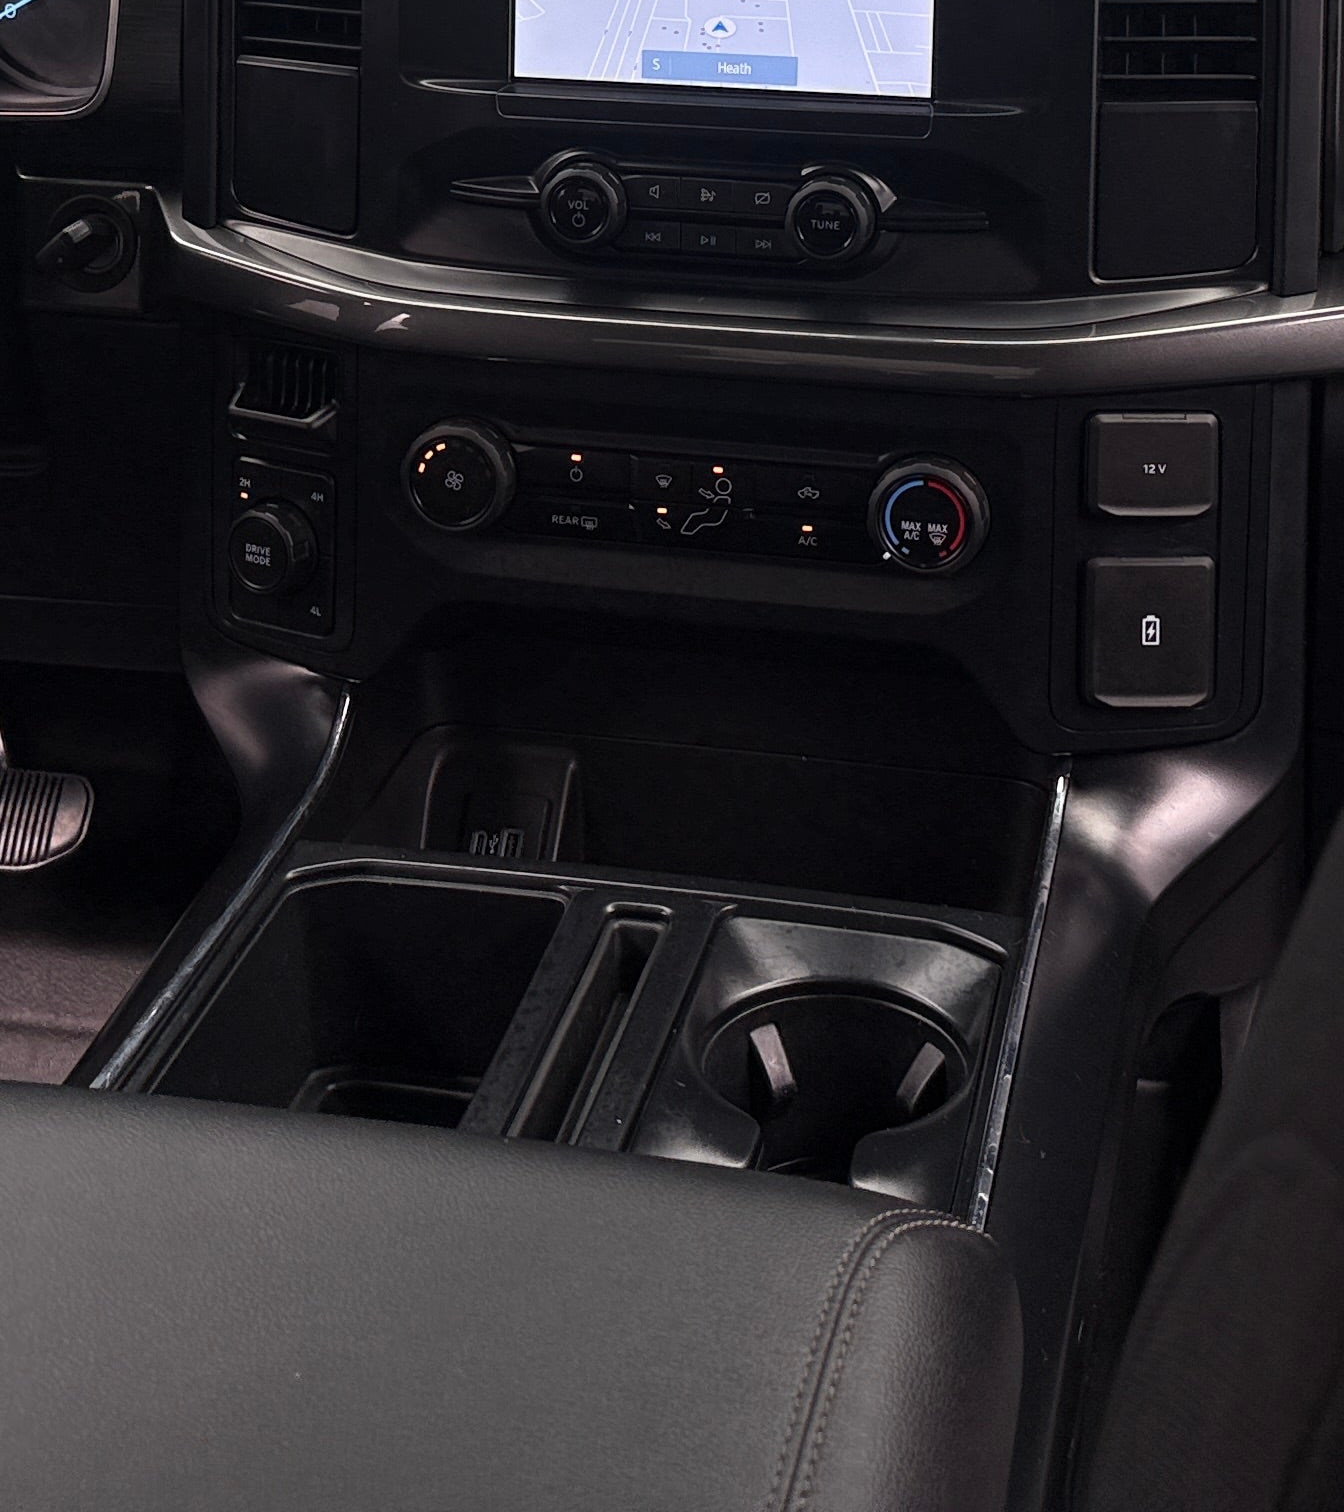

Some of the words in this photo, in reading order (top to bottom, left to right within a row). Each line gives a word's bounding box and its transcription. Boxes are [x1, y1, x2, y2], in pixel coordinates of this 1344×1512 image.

[4, 2, 17, 19] 0
[652, 57, 661, 71] S
[717, 61, 752, 75] Heath
[567, 199, 590, 211] VOL
[810, 219, 841, 231] TUNE
[1142, 463, 1156, 475] 12
[1157, 463, 1167, 475] V
[239, 476, 252, 489] 2H
[310, 491, 324, 503] 4H
[551, 514, 580, 526] REAR
[901, 520, 922, 532] MAX
[927, 522, 949, 534] MAX
[798, 535, 818, 547] A/C
[903, 531, 920, 541] A/C
[245, 543, 271, 557] DRIVE
[245, 552, 271, 567] MODE
[310, 604, 322, 617] 4L
